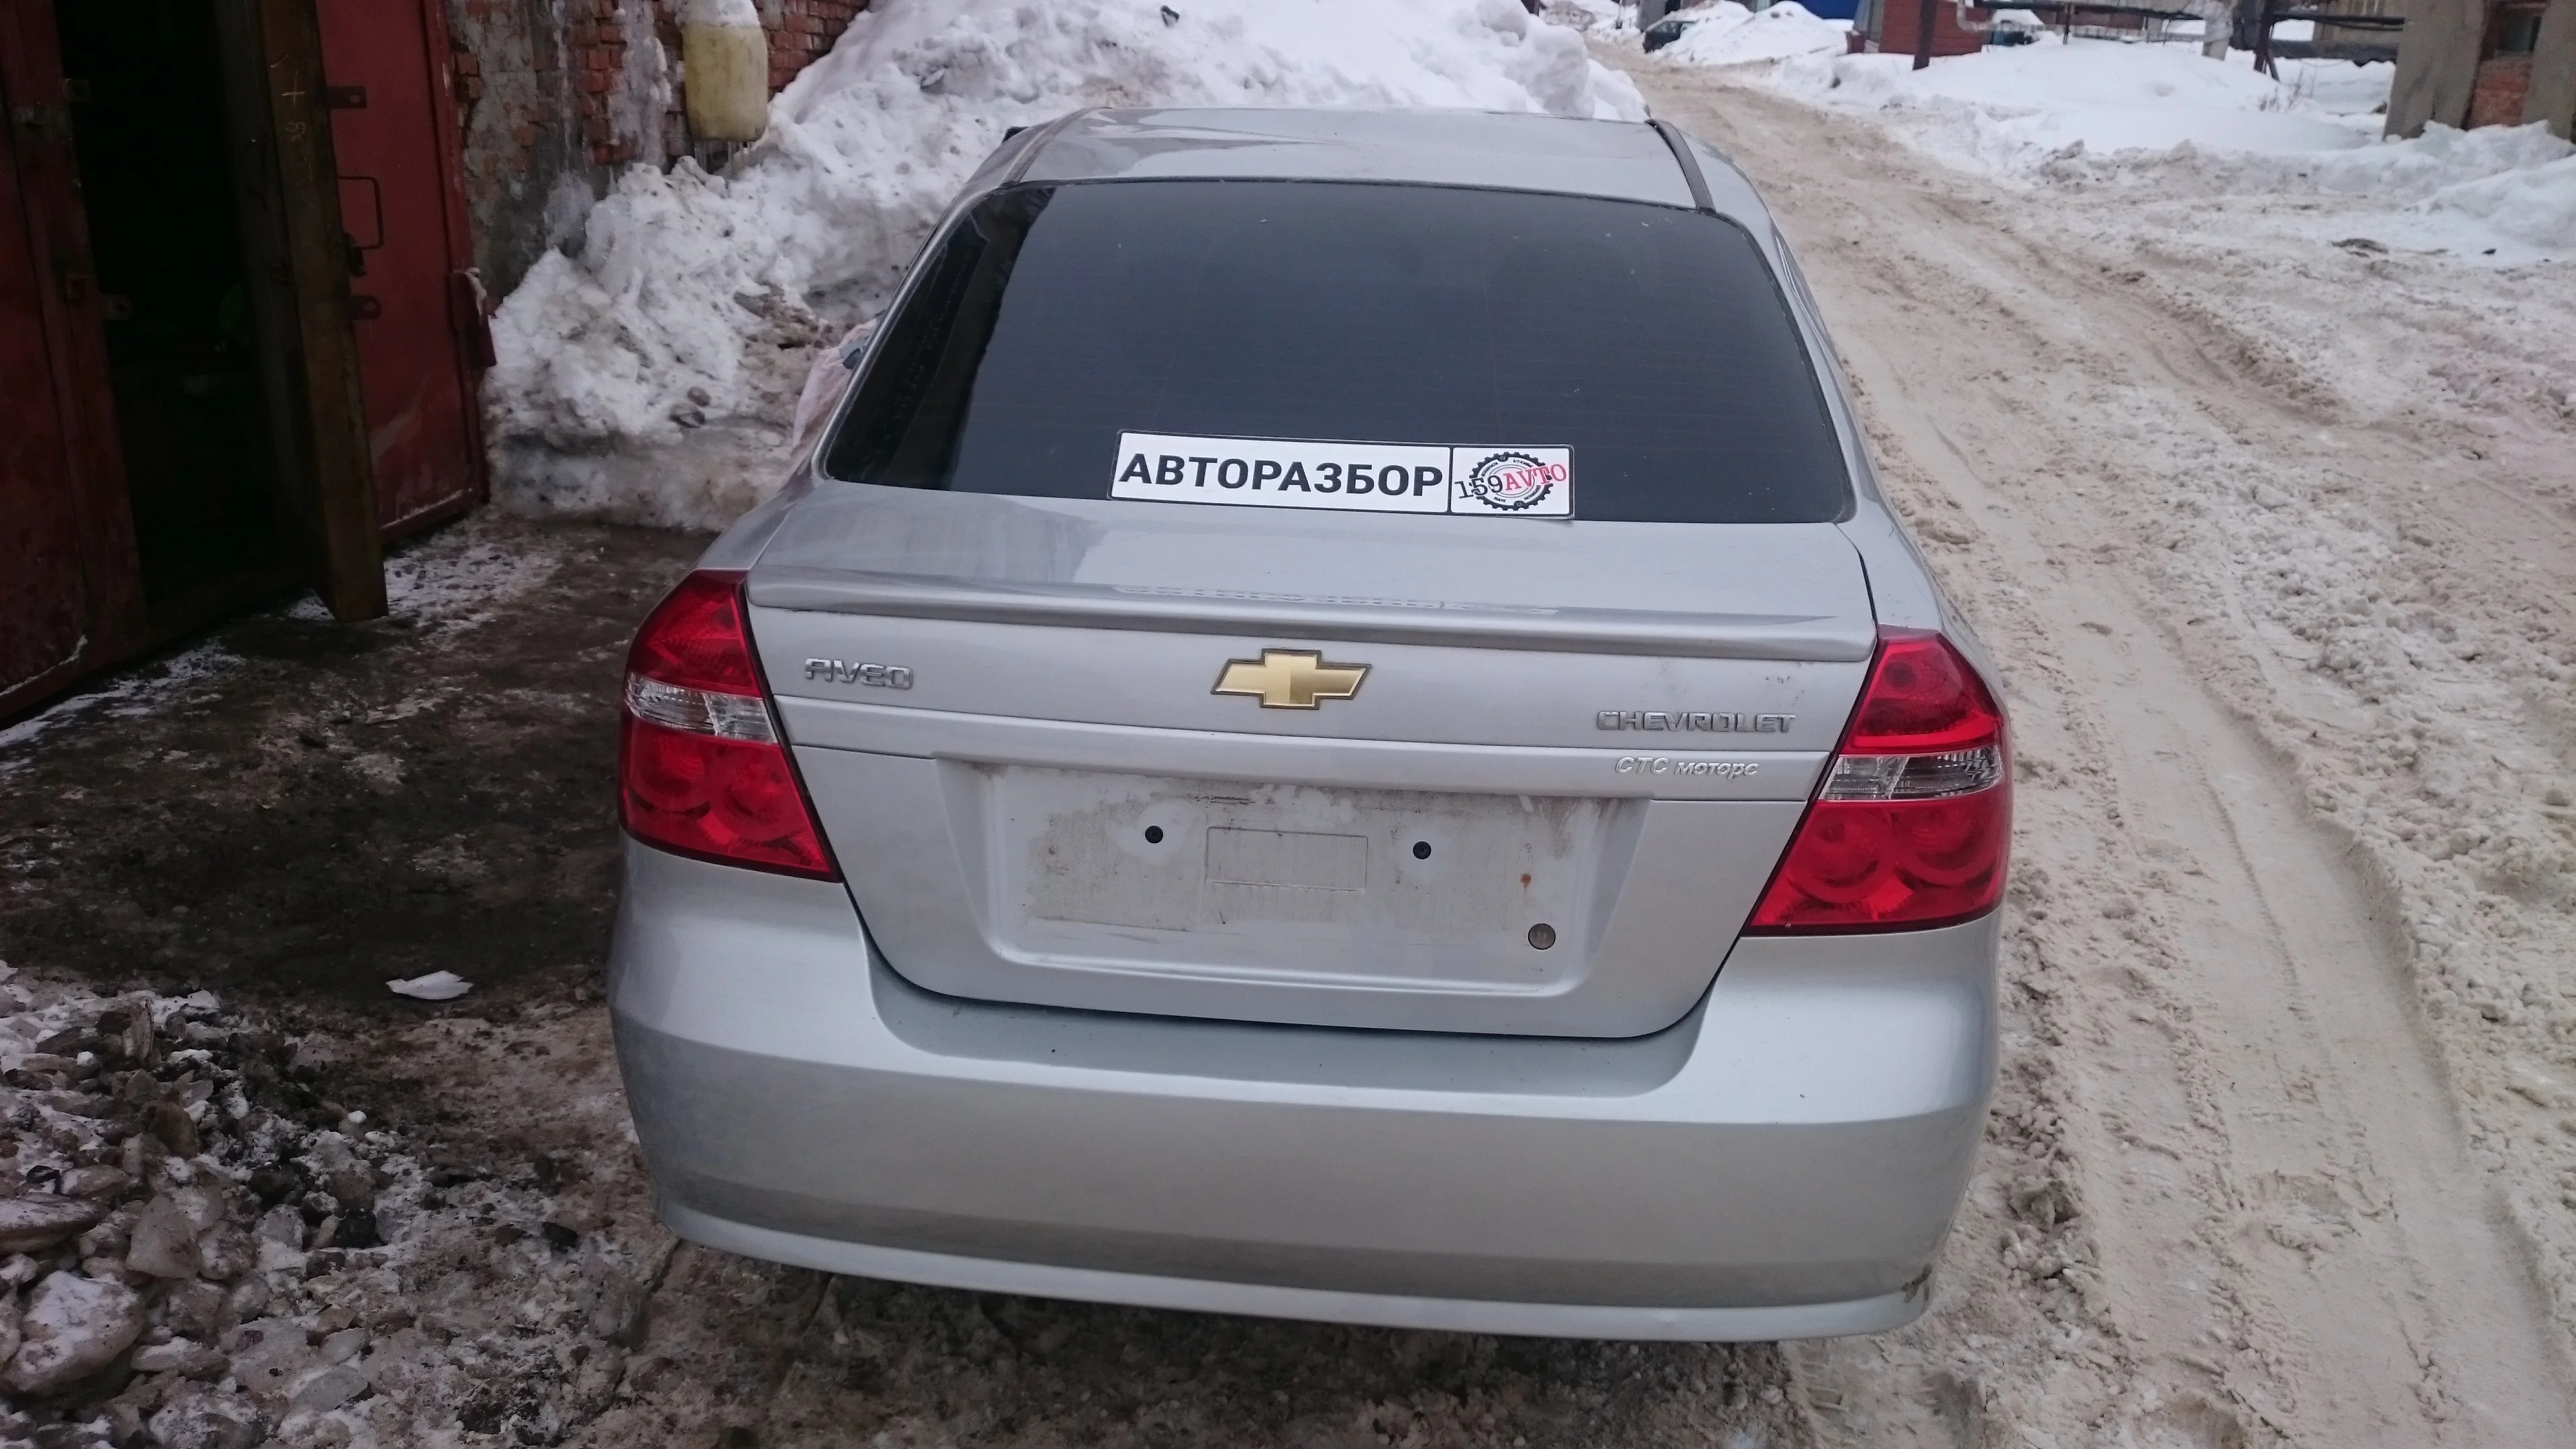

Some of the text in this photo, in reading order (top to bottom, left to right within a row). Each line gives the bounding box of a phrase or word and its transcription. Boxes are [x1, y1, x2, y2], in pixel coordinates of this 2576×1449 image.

[1118, 453, 1443, 496] АВТОРАЗБОР
[805, 657, 913, 690] AVEO
[1597, 710, 1796, 733] CHEVROLET
[1615, 756, 1760, 780] СТС моторс
